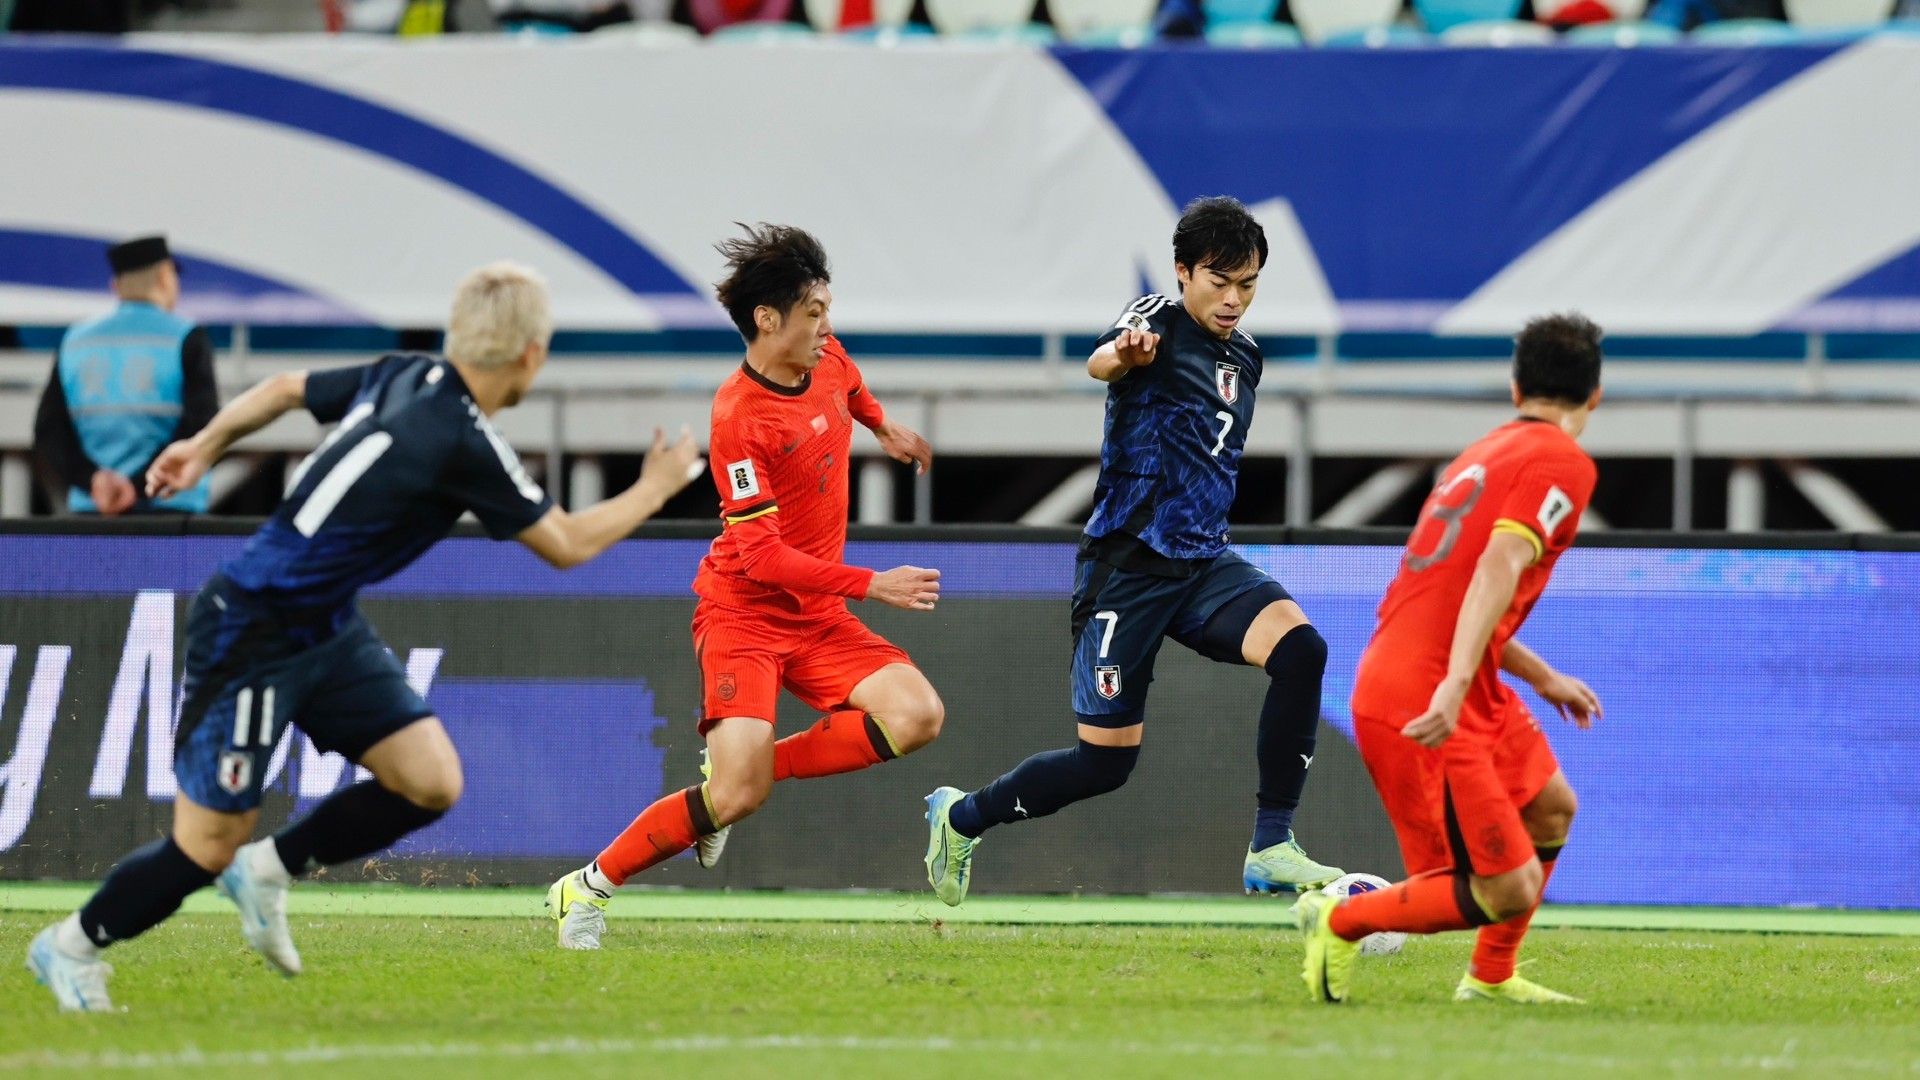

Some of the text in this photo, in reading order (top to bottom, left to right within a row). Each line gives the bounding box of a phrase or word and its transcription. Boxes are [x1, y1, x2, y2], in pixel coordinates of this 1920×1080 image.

[1211, 410, 1234, 457] 7
[1095, 610, 1118, 658] 7
[233, 686, 276, 746] 11
